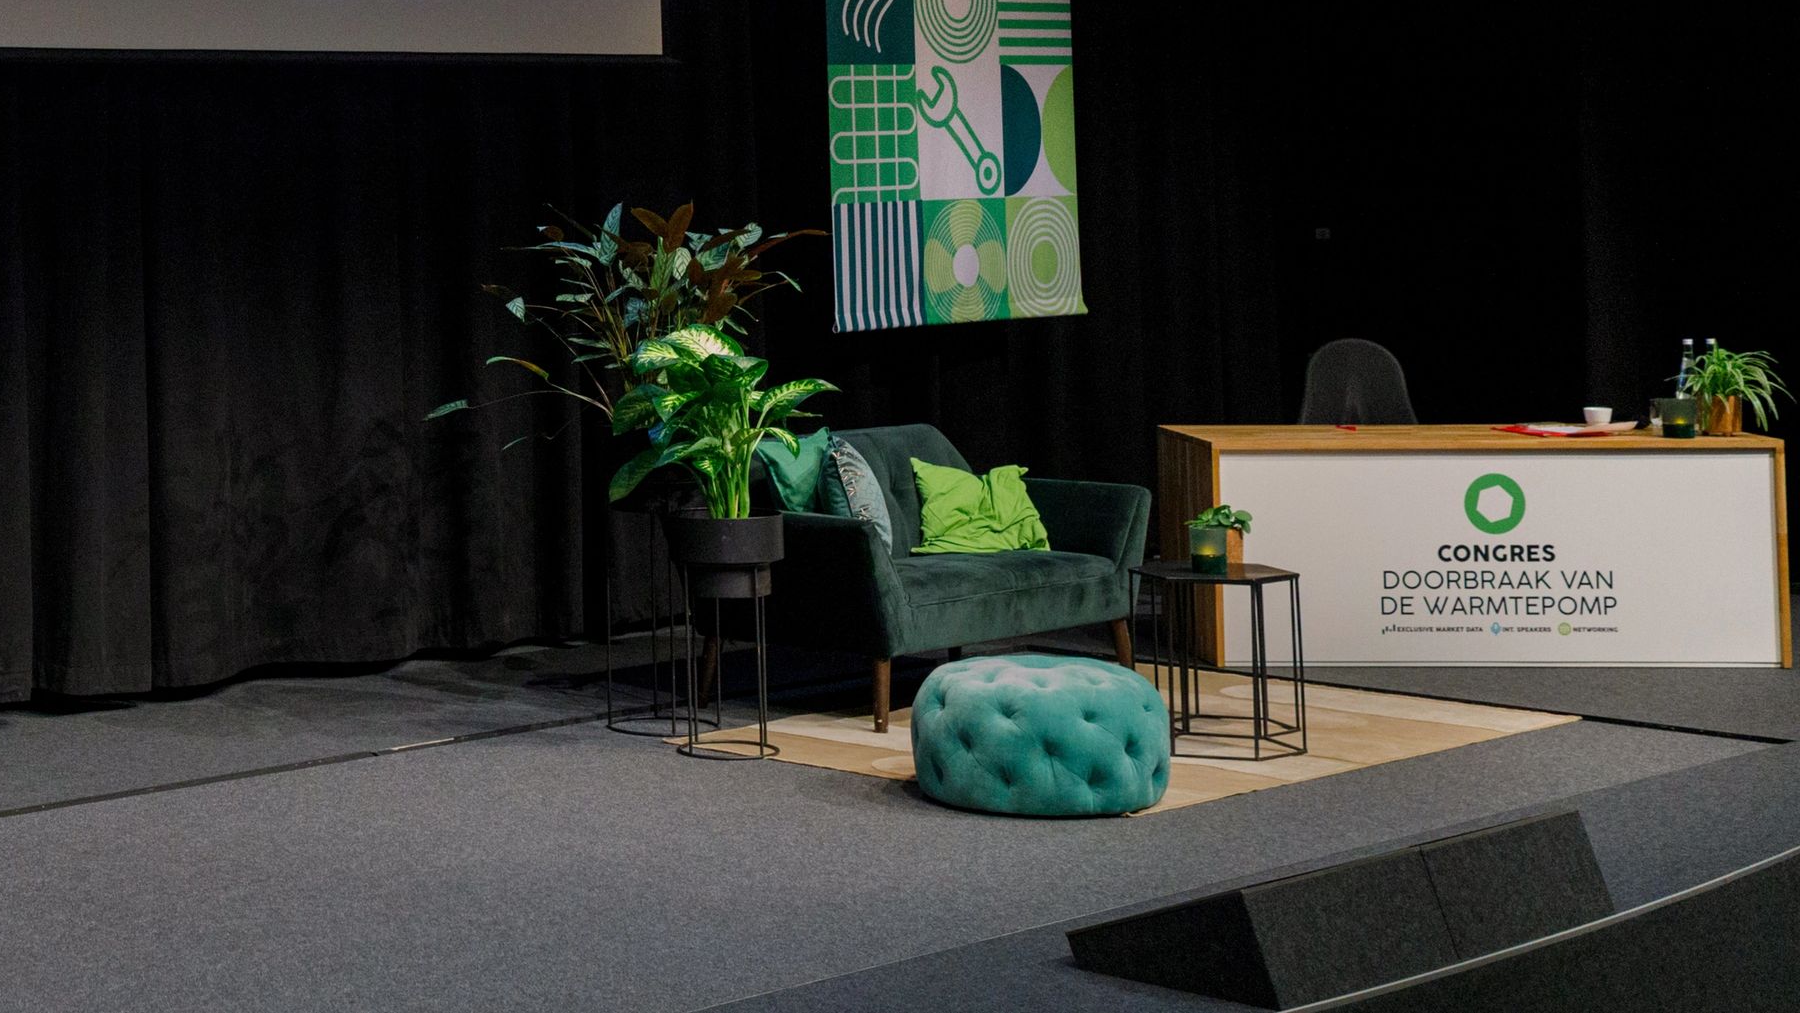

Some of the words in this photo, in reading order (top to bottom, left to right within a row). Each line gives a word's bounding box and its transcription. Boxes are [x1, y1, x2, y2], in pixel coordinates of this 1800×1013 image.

[1438, 544, 1556, 563] CONGRES
[1383, 570, 1552, 590] DOORBRAAK
[1560, 570, 1614, 590] VAN
[1381, 596, 1415, 616] DE
[1423, 596, 1617, 616] WARMTEPOMP
